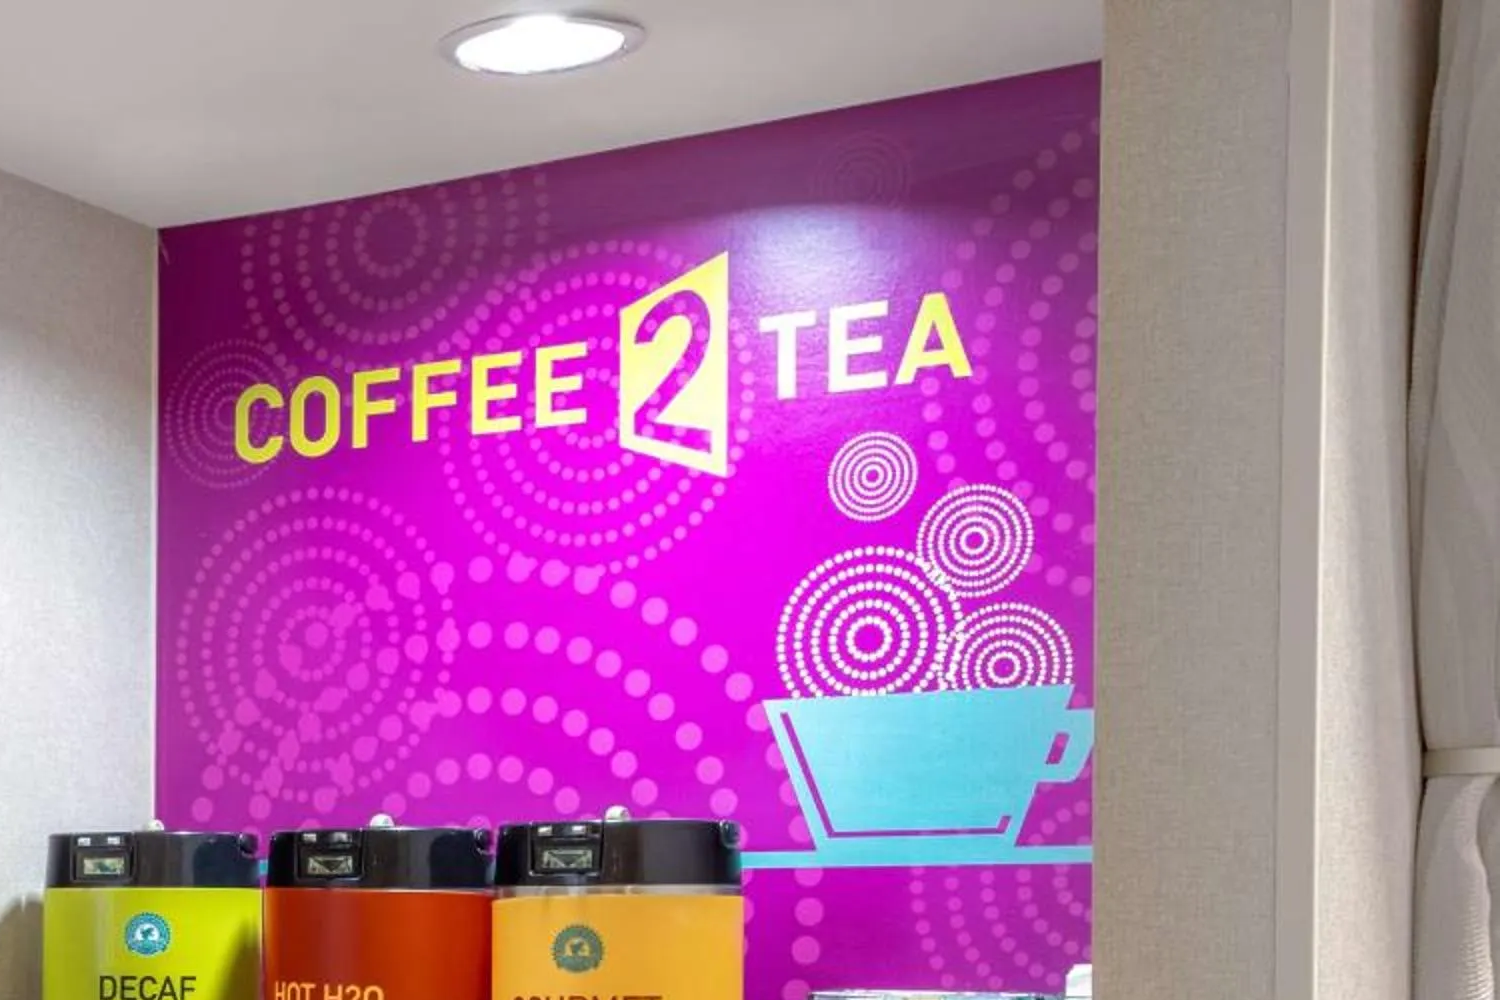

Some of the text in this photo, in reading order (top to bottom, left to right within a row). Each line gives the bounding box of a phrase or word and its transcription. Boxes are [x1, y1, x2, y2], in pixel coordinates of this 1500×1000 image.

[234, 284, 974, 464] COFFEE 2 TEA
